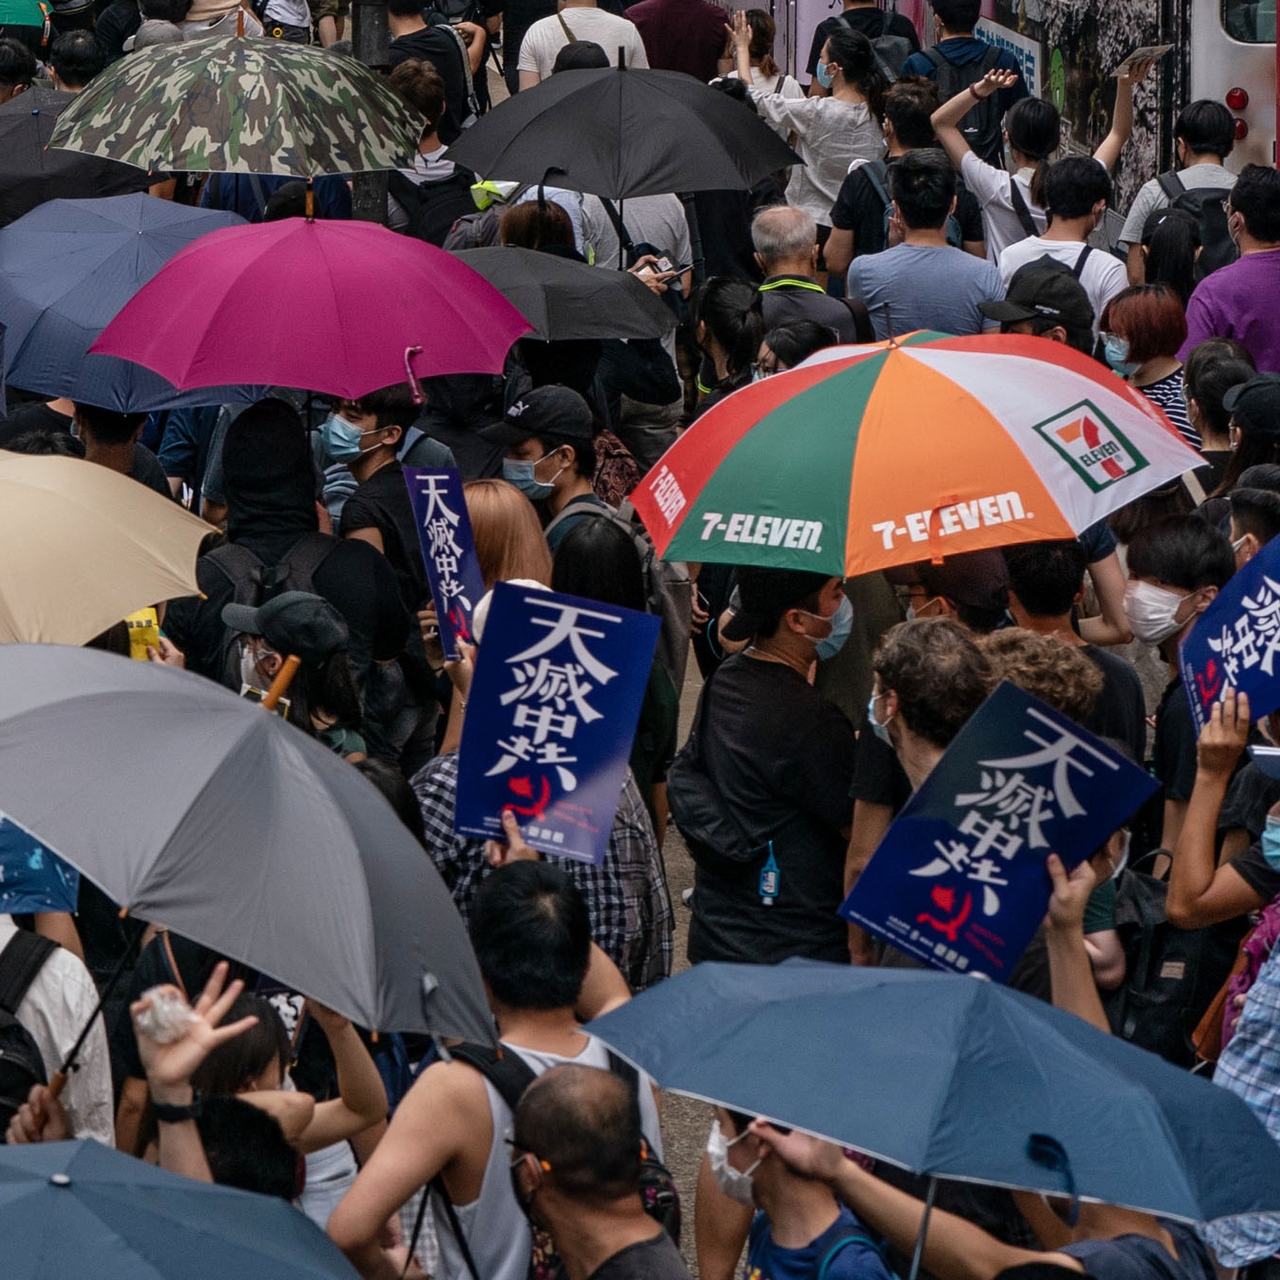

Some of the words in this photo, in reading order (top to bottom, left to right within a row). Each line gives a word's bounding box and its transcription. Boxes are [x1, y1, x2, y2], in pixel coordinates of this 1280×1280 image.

[1078, 442, 1118, 468] ELEVEN
[415, 474, 472, 615] 天滅中共
[702, 512, 822, 552] 7-ELEVEN
[482, 594, 622, 793] 天滅中共
[918, 705, 1119, 917] 天滅中共
